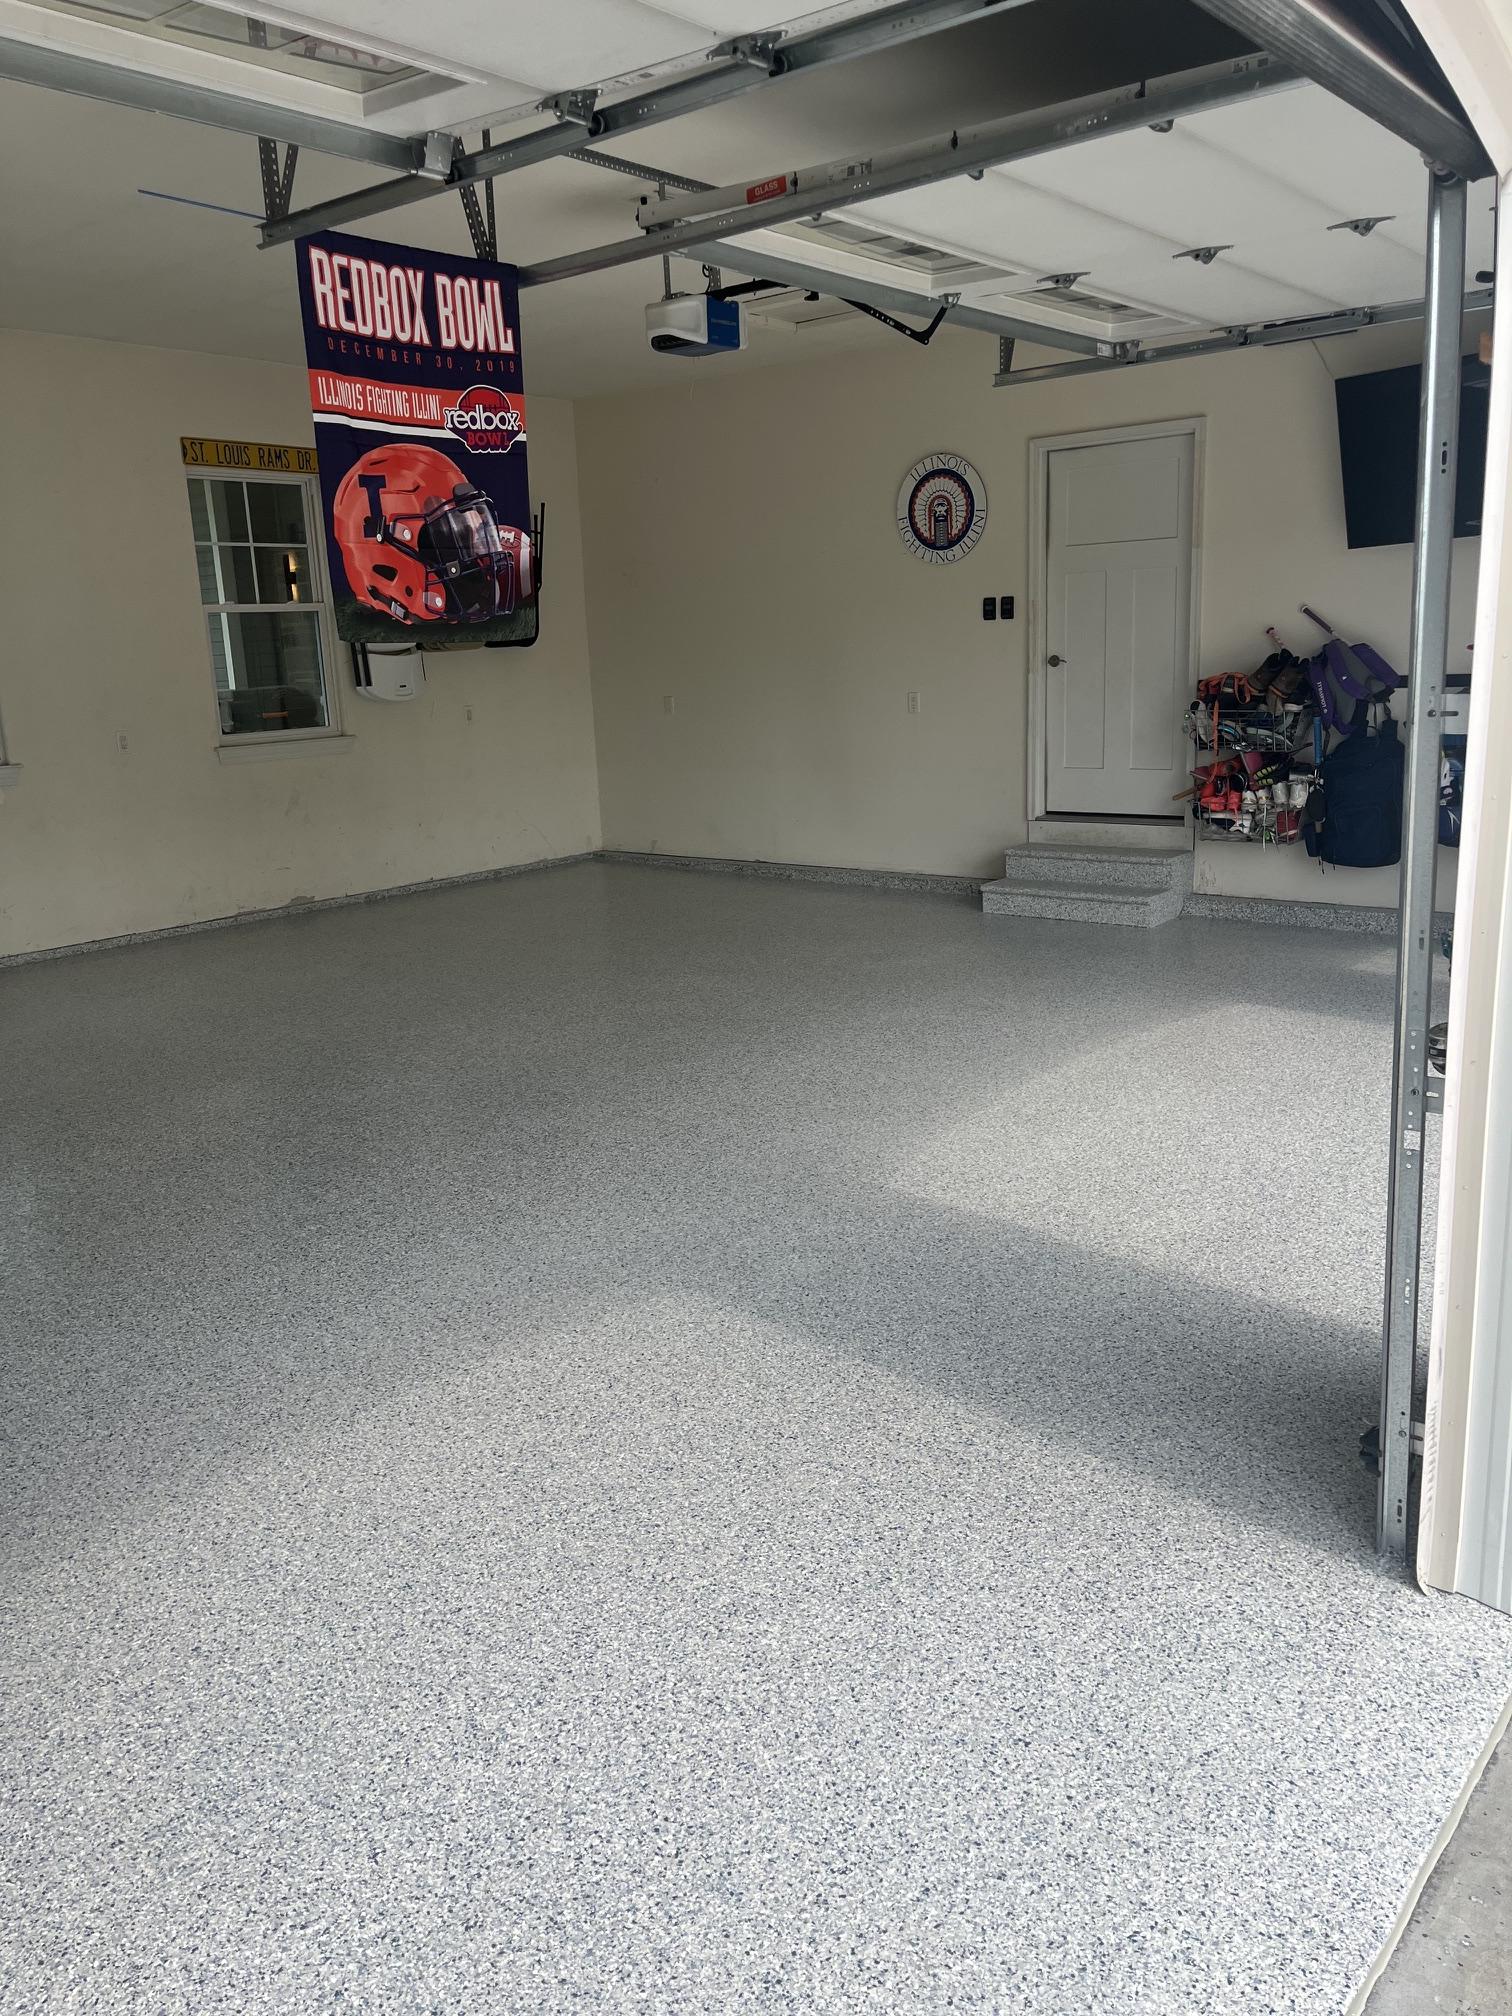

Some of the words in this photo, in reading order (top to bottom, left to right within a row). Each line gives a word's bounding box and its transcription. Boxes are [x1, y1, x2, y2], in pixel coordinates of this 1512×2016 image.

[754, 180, 779, 197] GLASS
[309, 246, 431, 346] REDBOX
[434, 273, 515, 354] BOWL
[328, 337, 422, 366] DECEMBER
[435, 355, 463, 371] 30,
[475, 359, 515, 373] 2019
[318, 376, 364, 411] ILLINOIS
[366, 385, 409, 418] FIGHTING
[412, 392, 441, 420] ILLINI
[445, 404, 519, 430] redbox
[466, 431, 510, 446] BOWL
[190, 441, 209, 463] ST.
[216, 443, 251, 466] LOUIS
[258, 447, 290, 469] RAMS
[296, 450, 316, 471] DR.
[910, 455, 970, 482] ILLINOIS
[898, 516, 956, 563] FIGHTING
[959, 509, 986, 554] ILLINI
